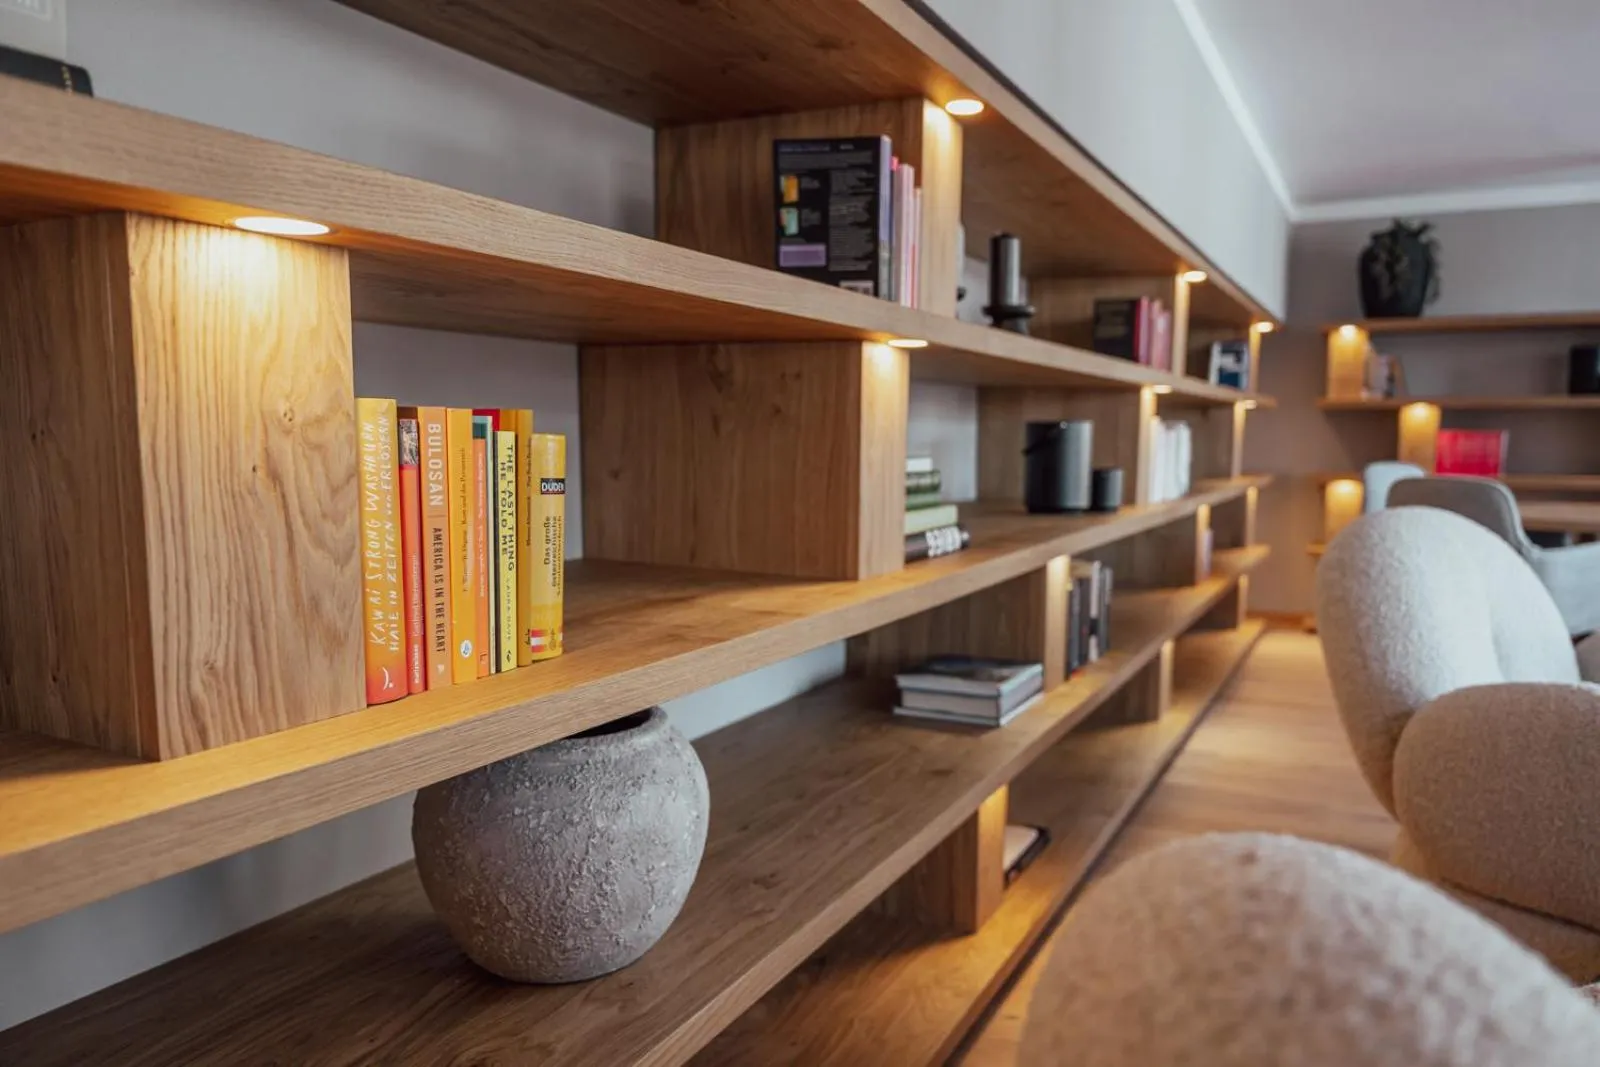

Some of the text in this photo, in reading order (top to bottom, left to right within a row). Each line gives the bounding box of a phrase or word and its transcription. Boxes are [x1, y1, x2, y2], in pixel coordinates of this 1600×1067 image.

[427, 423, 443, 507] BULOSAN
[500, 462, 508, 556] HE TOLD ME
[506, 480, 514, 518] LAST
[365, 519, 384, 581] STRONG
[507, 525, 515, 571] THING
[543, 515, 551, 566] Das große
[432, 527, 446, 653] AMERICA IS IN THE HEART
